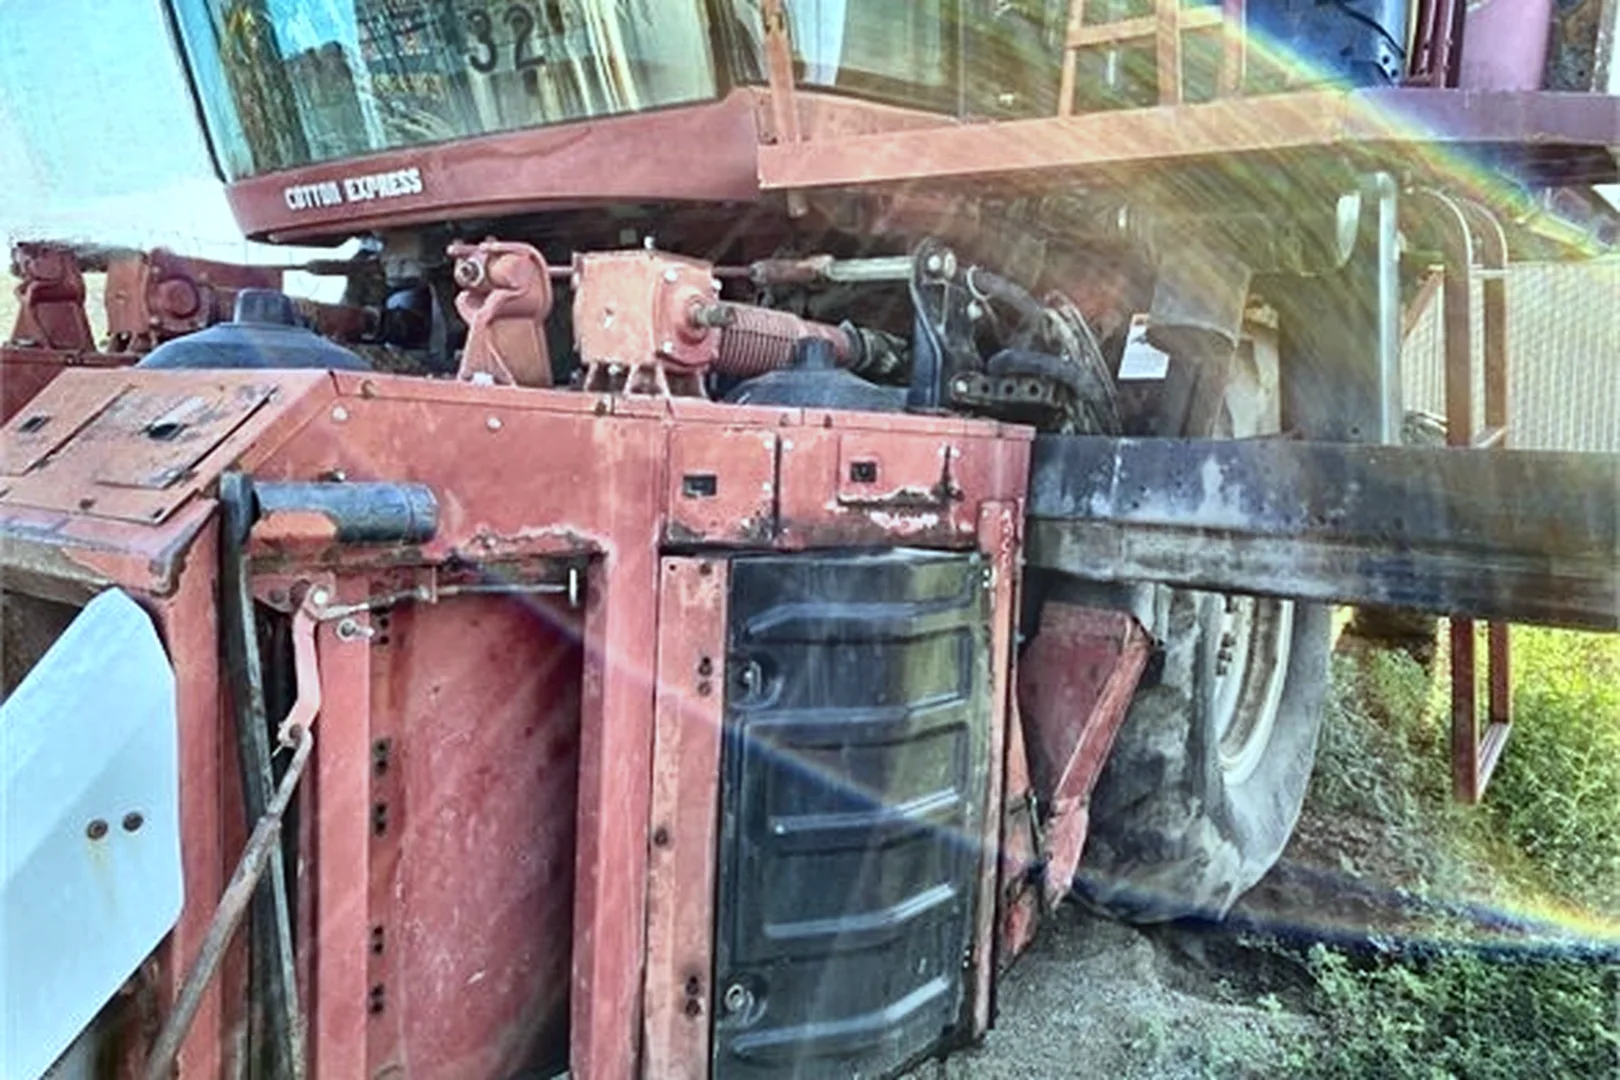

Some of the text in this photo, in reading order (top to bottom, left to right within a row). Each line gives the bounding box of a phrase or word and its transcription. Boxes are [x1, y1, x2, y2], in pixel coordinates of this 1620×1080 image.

[466, 4, 547, 74] 32
[284, 167, 423, 210] COTTON EXPRESS
